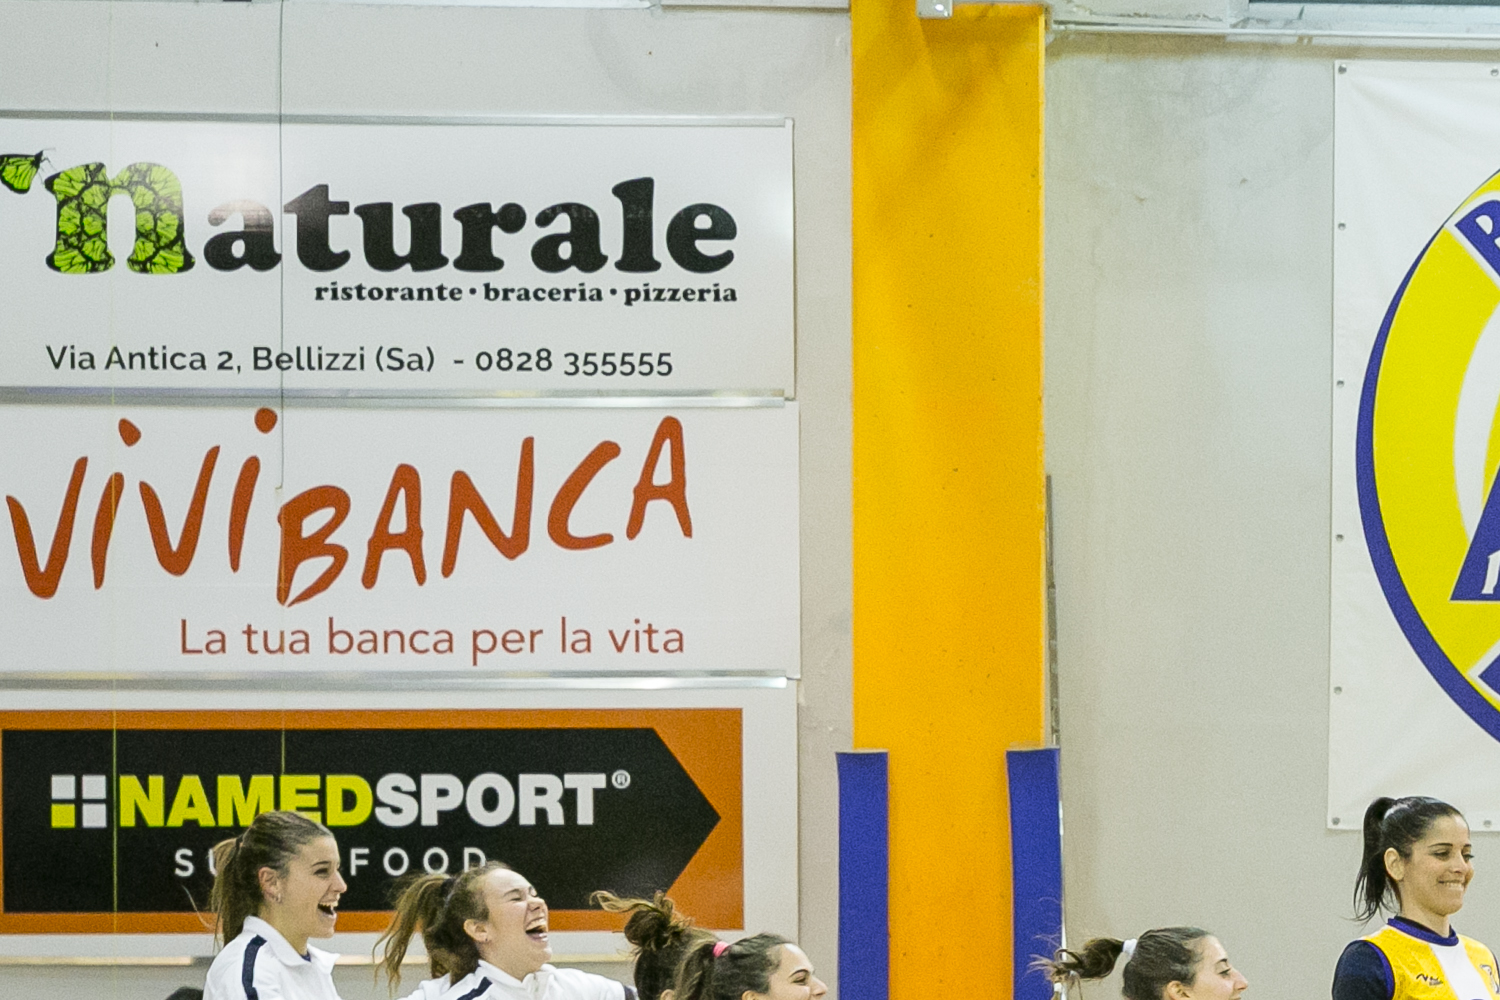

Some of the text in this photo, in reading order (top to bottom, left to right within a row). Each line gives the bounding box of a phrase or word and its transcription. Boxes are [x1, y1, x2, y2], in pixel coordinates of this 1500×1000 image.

[315, 281, 737, 306] ristorante braceria pizzeria
[46, 345, 95, 370] Via
[105, 346, 206, 370] Antica
[218, 351, 240, 374] 2,
[253, 346, 364, 371] Bellizzi
[376, 346, 434, 372] (Sa)
[476, 348, 552, 371] 0828
[564, 352, 672, 376] 355555
[181, 617, 683, 666] La tua banca per la vita
